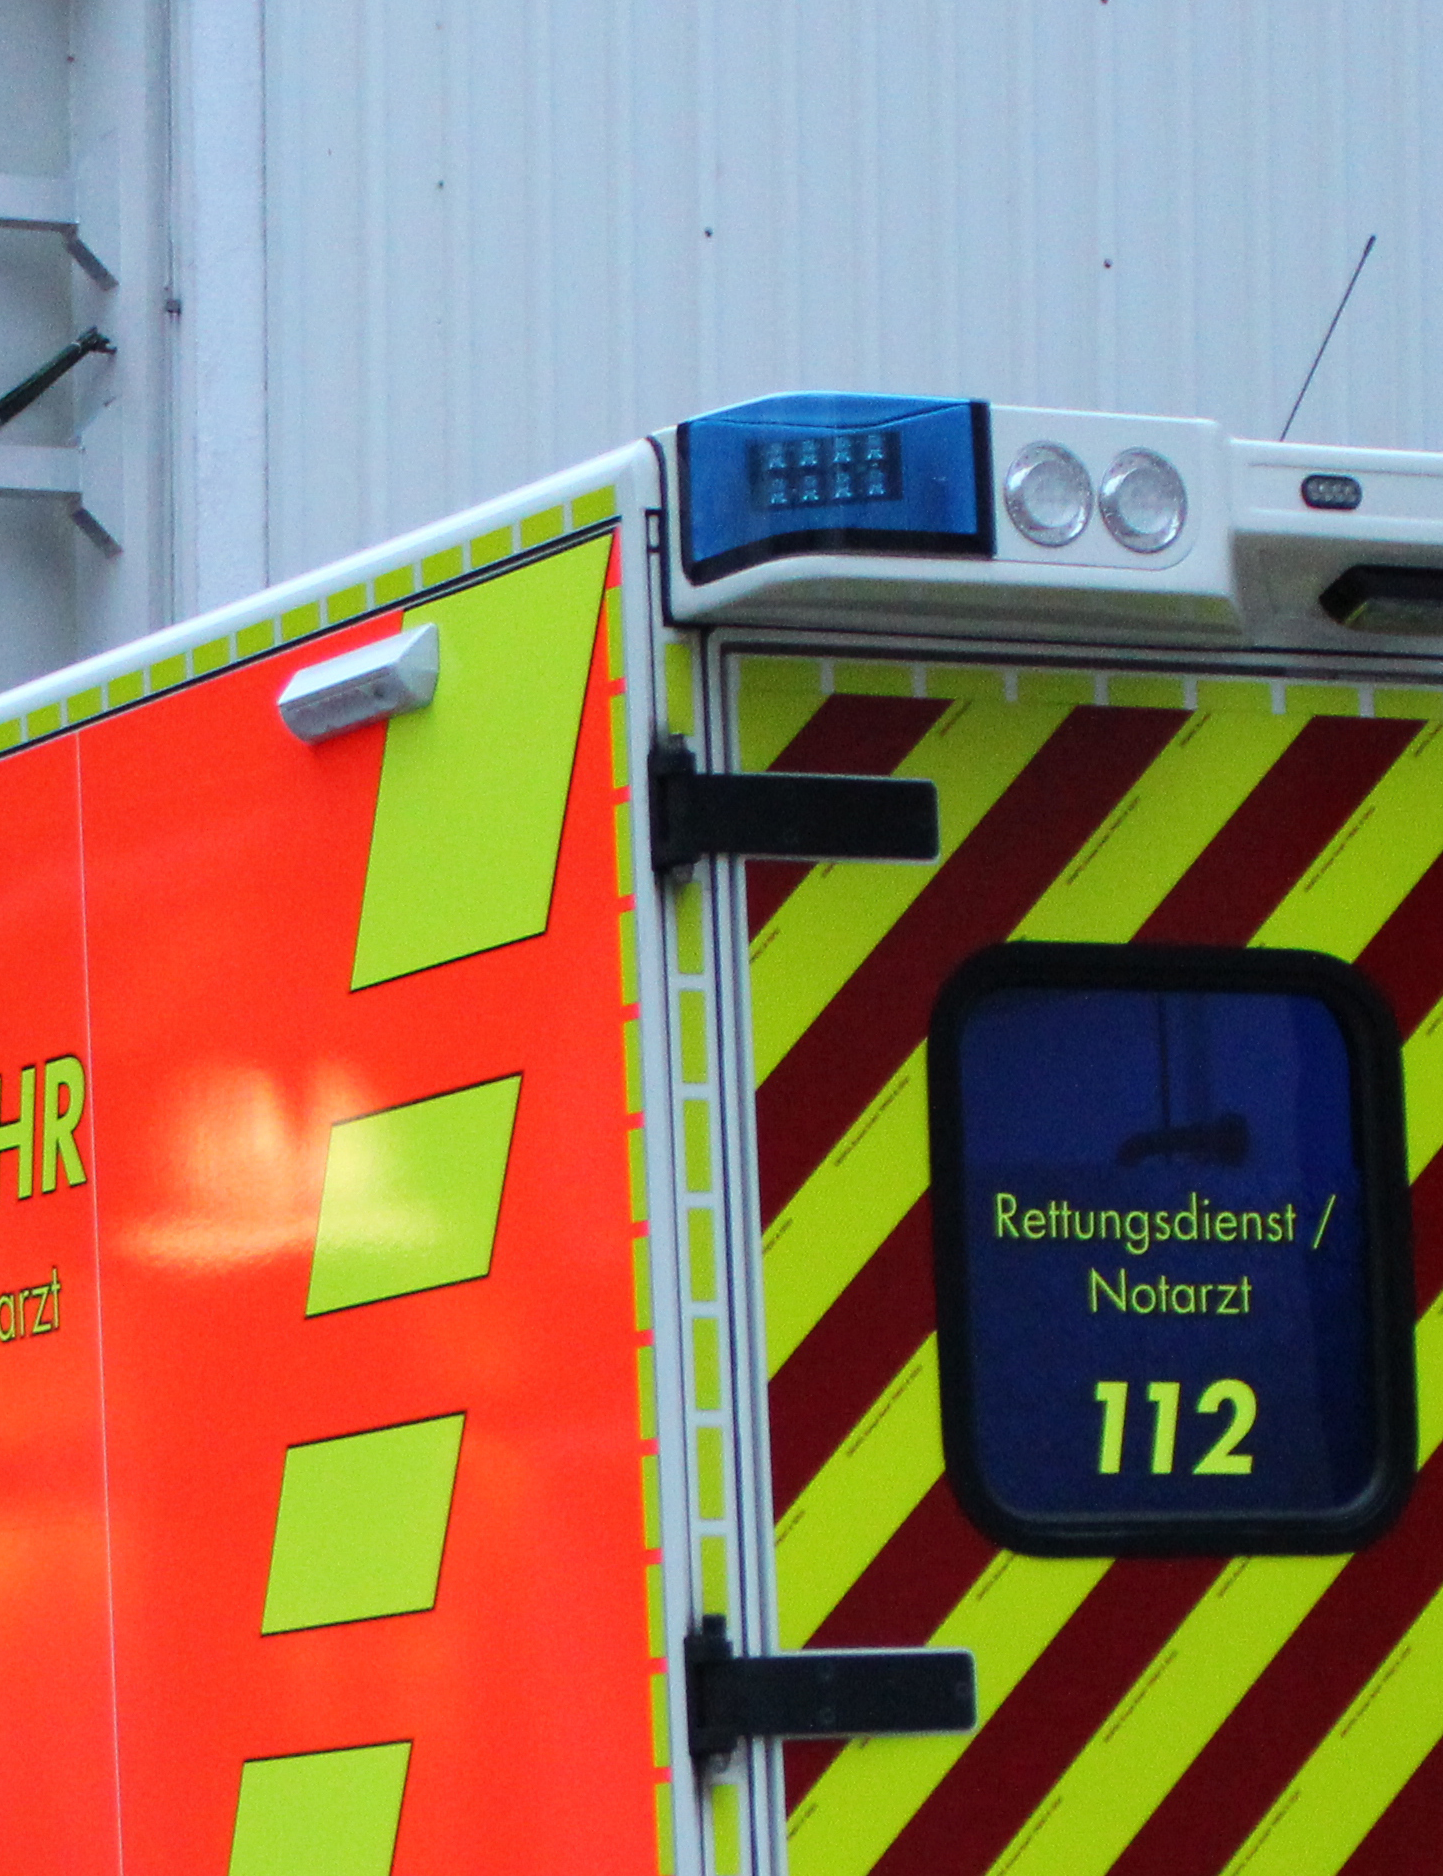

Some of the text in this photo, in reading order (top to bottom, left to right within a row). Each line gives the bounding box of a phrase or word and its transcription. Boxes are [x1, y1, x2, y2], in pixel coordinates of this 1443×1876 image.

[994, 1191, 1336, 1255] Rettungsdienst /
[1088, 1267, 1253, 1314] Notarzt
[1094, 1378, 1259, 1475] 112
